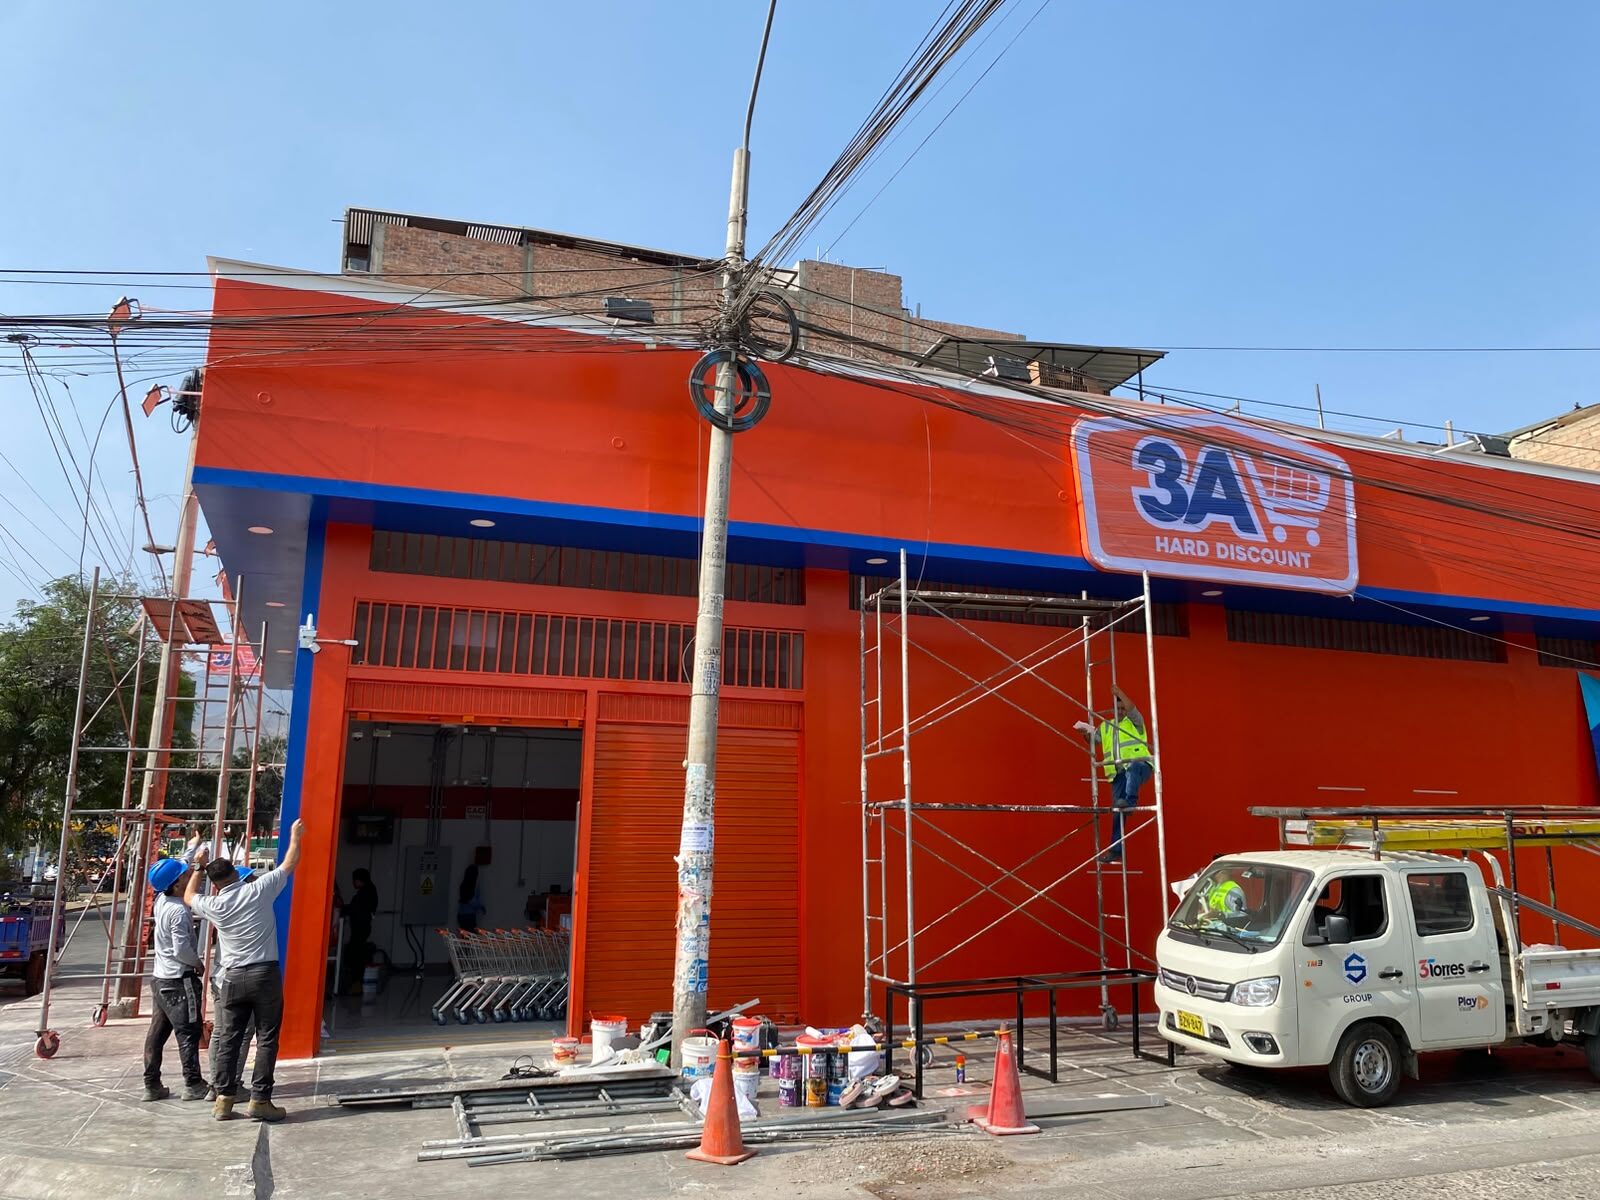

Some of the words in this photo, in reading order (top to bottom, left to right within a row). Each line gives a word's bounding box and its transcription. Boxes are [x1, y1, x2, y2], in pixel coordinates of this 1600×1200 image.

[1135, 438, 1264, 538] 3A
[1155, 535, 1210, 558] HARD
[1216, 542, 1311, 569] DISCOUNT
[1343, 993, 1372, 1004] GROUP
[1457, 996, 1477, 1008] Play
